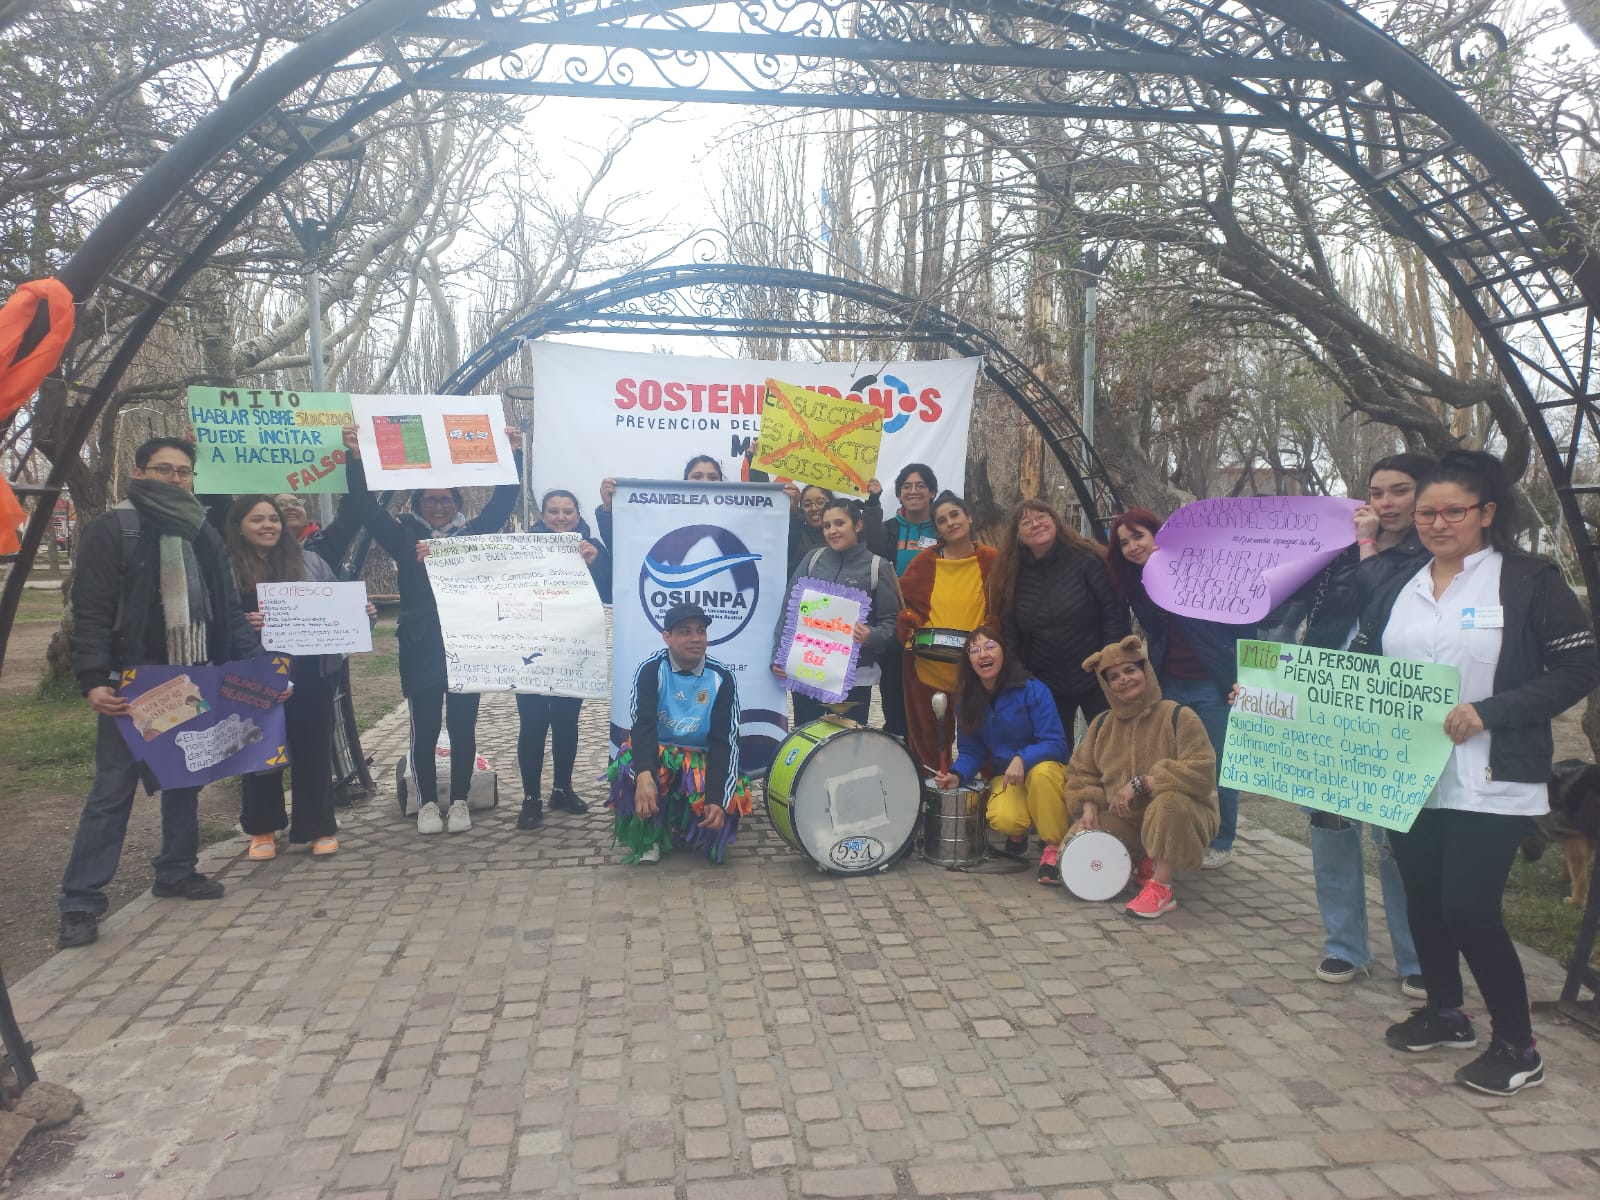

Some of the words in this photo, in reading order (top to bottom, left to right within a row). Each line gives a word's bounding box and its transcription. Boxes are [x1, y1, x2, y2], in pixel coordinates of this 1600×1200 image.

[219, 391, 300, 408] MITO
[191, 406, 249, 425] HABLAR
[252, 410, 296, 425] SOBRE
[295, 412, 352, 427] SUICIDIO
[615, 415, 720, 431] PREVENCION
[730, 420, 760, 431] DEL
[197, 428, 247, 443] PUEDE
[212, 447, 225, 463] A
[235, 447, 315, 464] HACERLO
[286, 450, 347, 491] FALSO
[628, 492, 709, 505] ASAMBLEA
[713, 494, 774, 507] OSUNPA
[650, 590, 747, 608] OSUNPA
[1249, 583, 1266, 599] 40
[1242, 644, 1279, 670] Mito
[1298, 648, 1313, 665] LA
[1318, 652, 1381, 675] PERSONA
[1390, 662, 1424, 680] QUE
[1342, 674, 1360, 691] EN
[1234, 686, 1295, 721] Realidad
[1309, 706, 1325, 725] La
[1391, 721, 1412, 741] de
[1231, 717, 1275, 737] suicidio
[1282, 728, 1333, 749] aparece
[1341, 738, 1389, 761] cuando
[1396, 744, 1410, 765] el
[1229, 733, 1291, 758] sufrimiento
[1296, 748, 1309, 762] es
[1313, 749, 1335, 768] tan
[1340, 757, 1387, 779] intenso
[1392, 769, 1416, 788] que
[1227, 751, 1264, 770] vuelve
[1272, 757, 1348, 789] insoportable
[1351, 781, 1360, 799] y
[1363, 782, 1377, 795] no
[1222, 765, 1249, 784] otra
[1253, 771, 1288, 793] salida
[1291, 783, 1315, 801] para
[1321, 790, 1352, 813] dejar
[1356, 797, 1373, 813] de
[1380, 804, 1413, 824] sufrir
